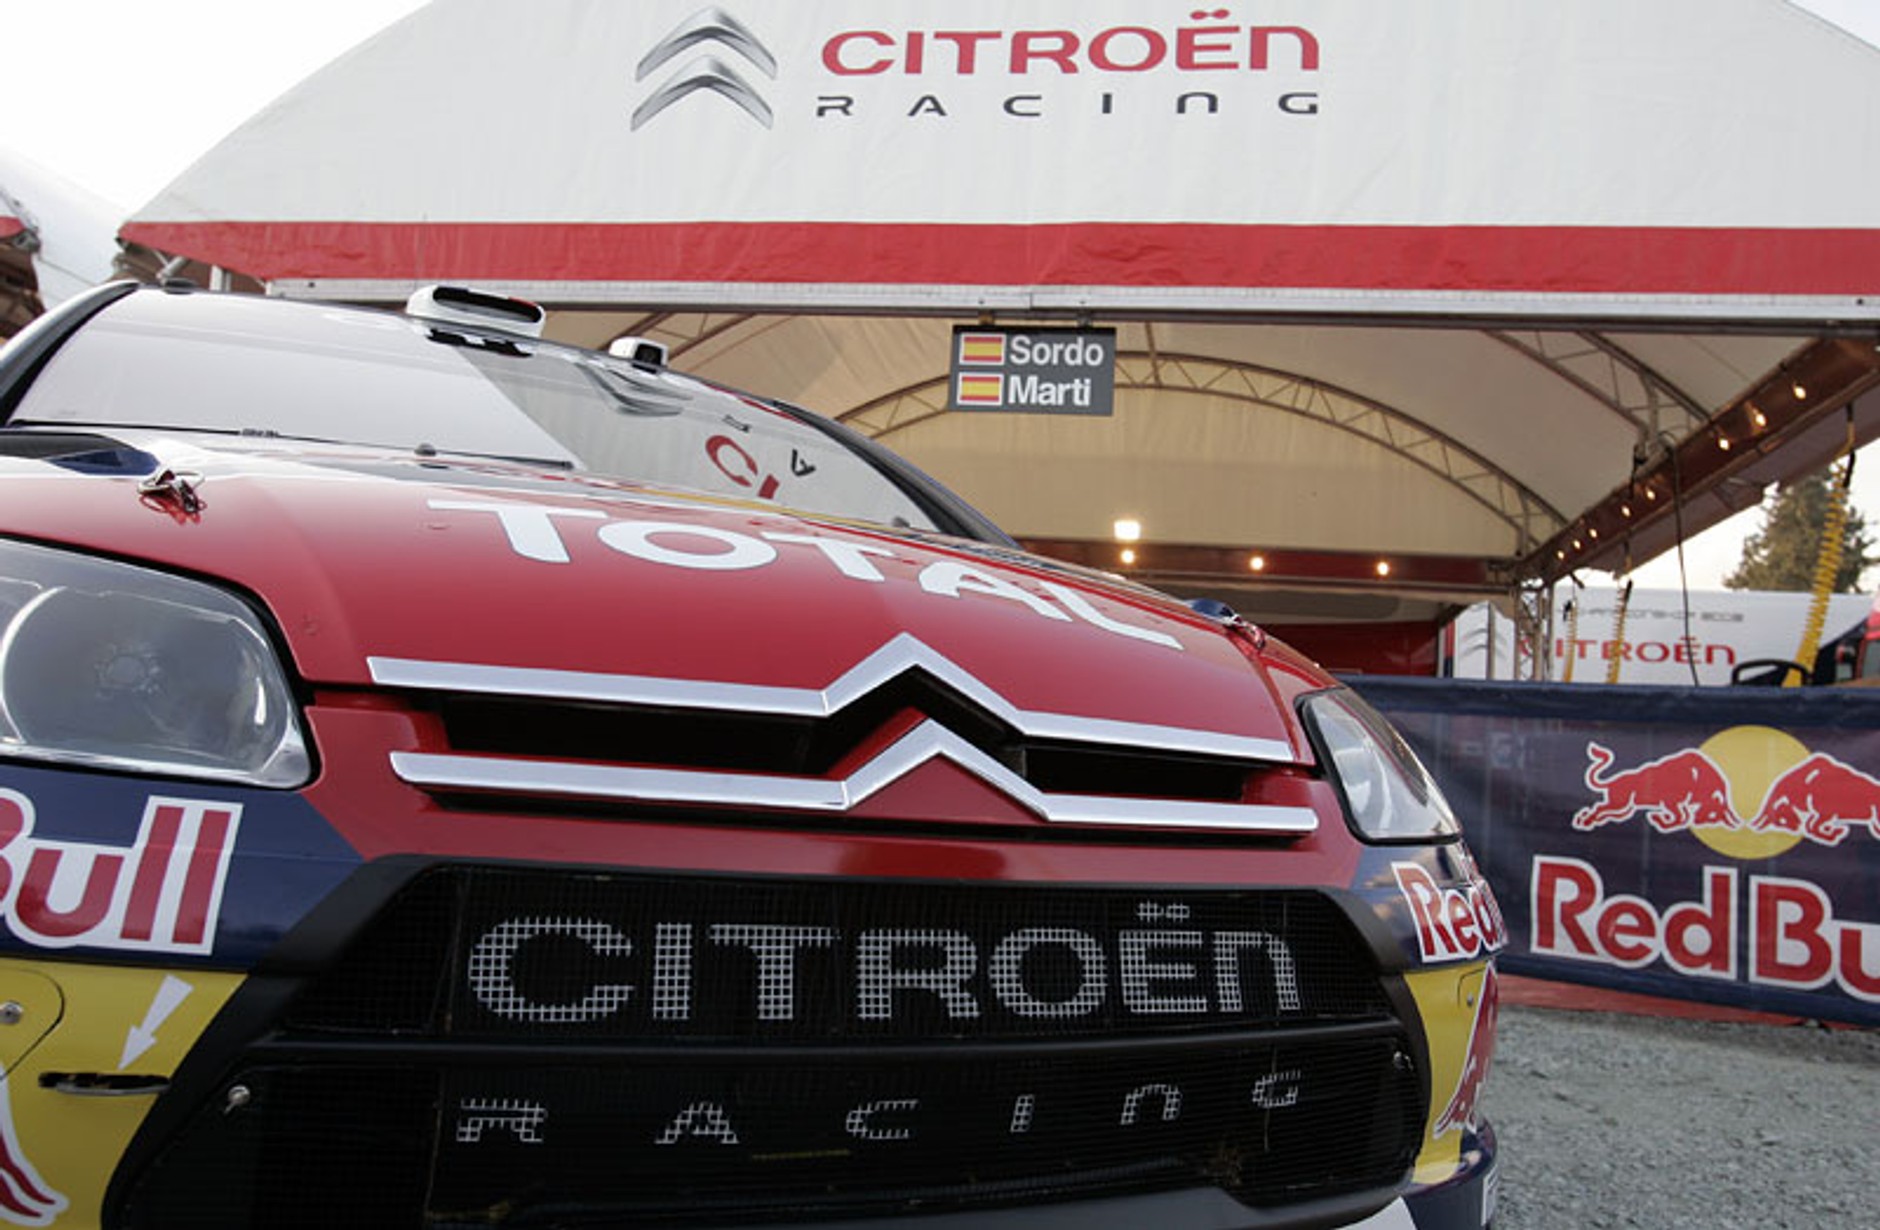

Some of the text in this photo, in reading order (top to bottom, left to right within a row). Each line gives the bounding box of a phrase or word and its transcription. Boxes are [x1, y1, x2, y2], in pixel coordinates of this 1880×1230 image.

[815, 91, 1319, 118] RACING
[1009, 335, 1104, 366] Sordo
[1007, 375, 1092, 406] Marti
[427, 499, 1184, 651] TOTAL
[1530, 854, 1738, 981] Red
[456, 1070, 1302, 1144] RACING
